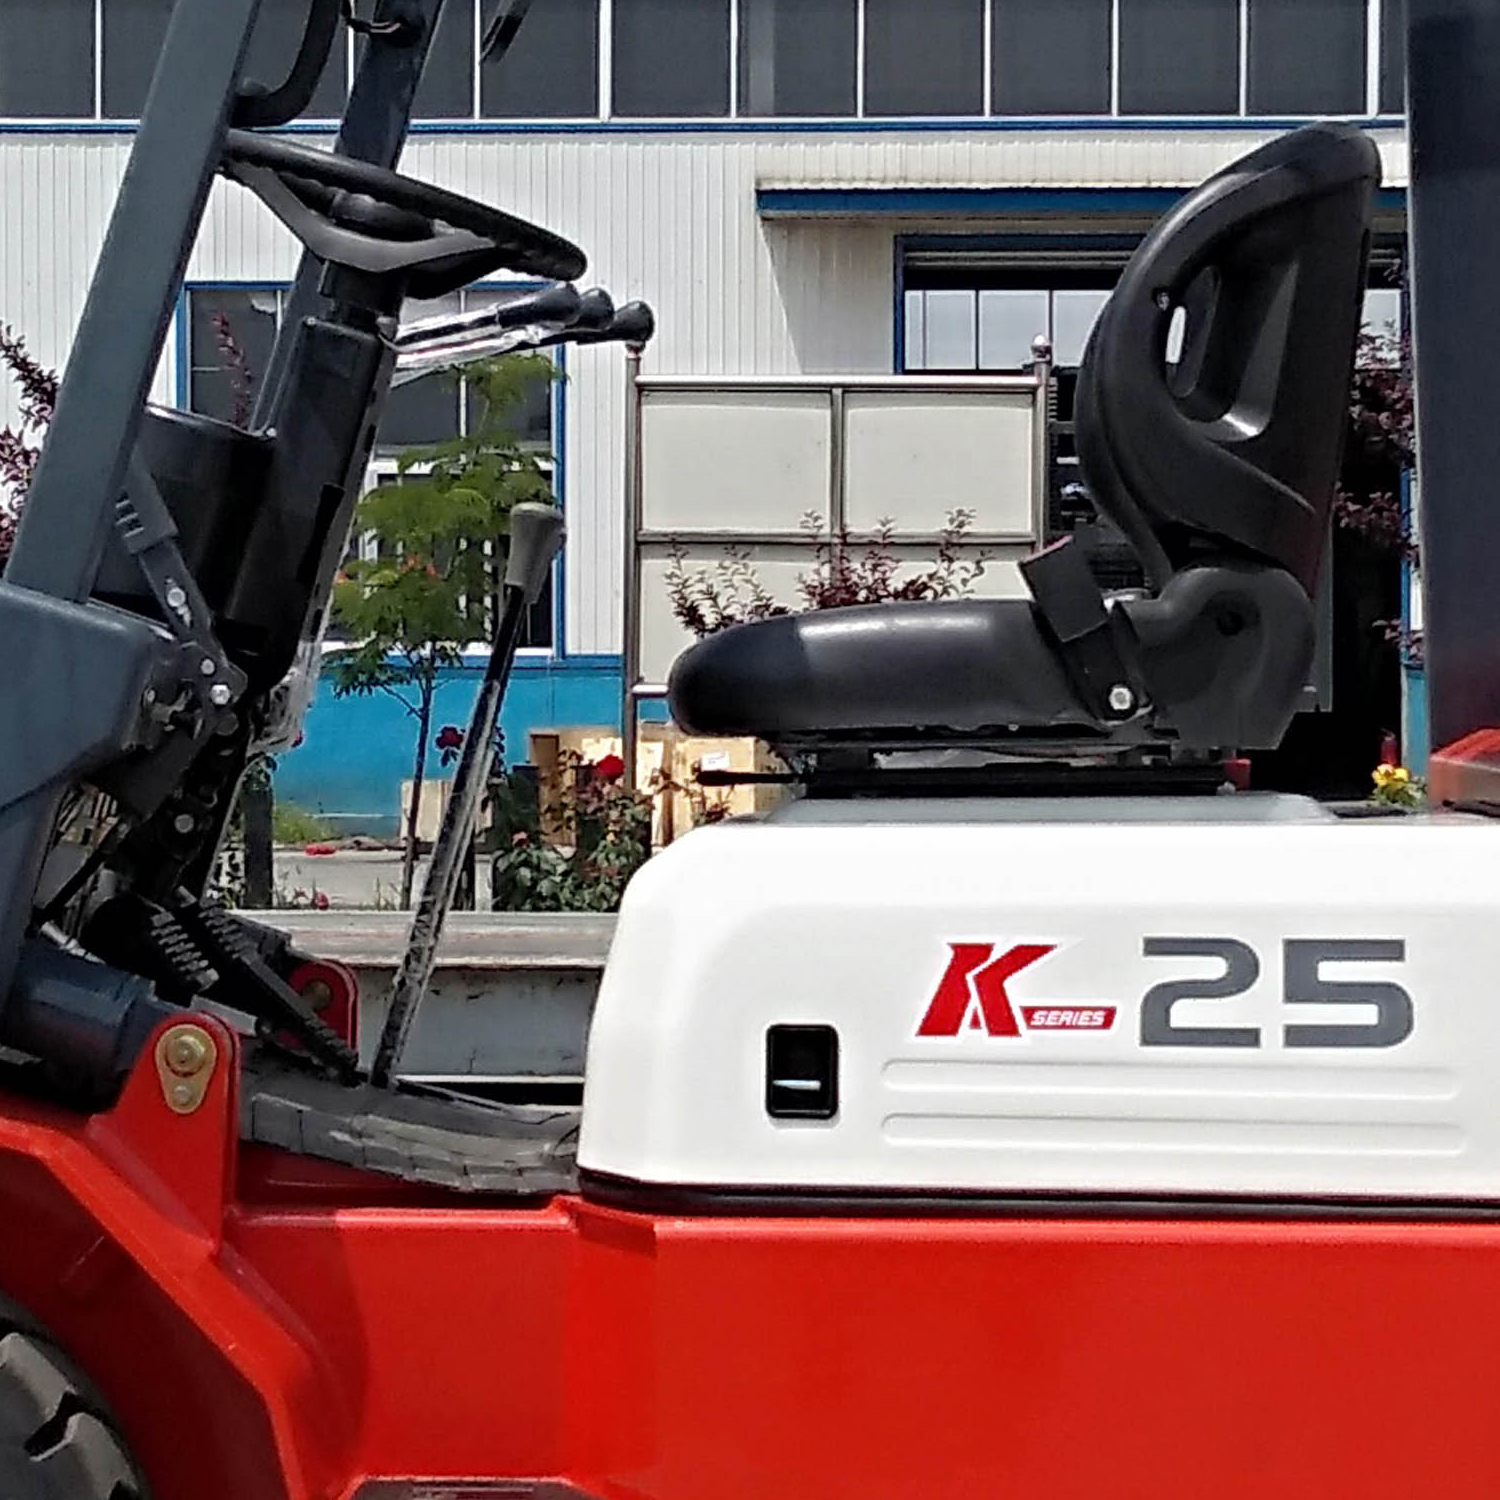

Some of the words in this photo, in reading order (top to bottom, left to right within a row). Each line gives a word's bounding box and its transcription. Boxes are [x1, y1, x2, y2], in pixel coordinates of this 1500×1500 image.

[915, 942, 1058, 1037] K
[1030, 1009, 1106, 1026] SERIES
[1139, 936, 1415, 1048] 25
